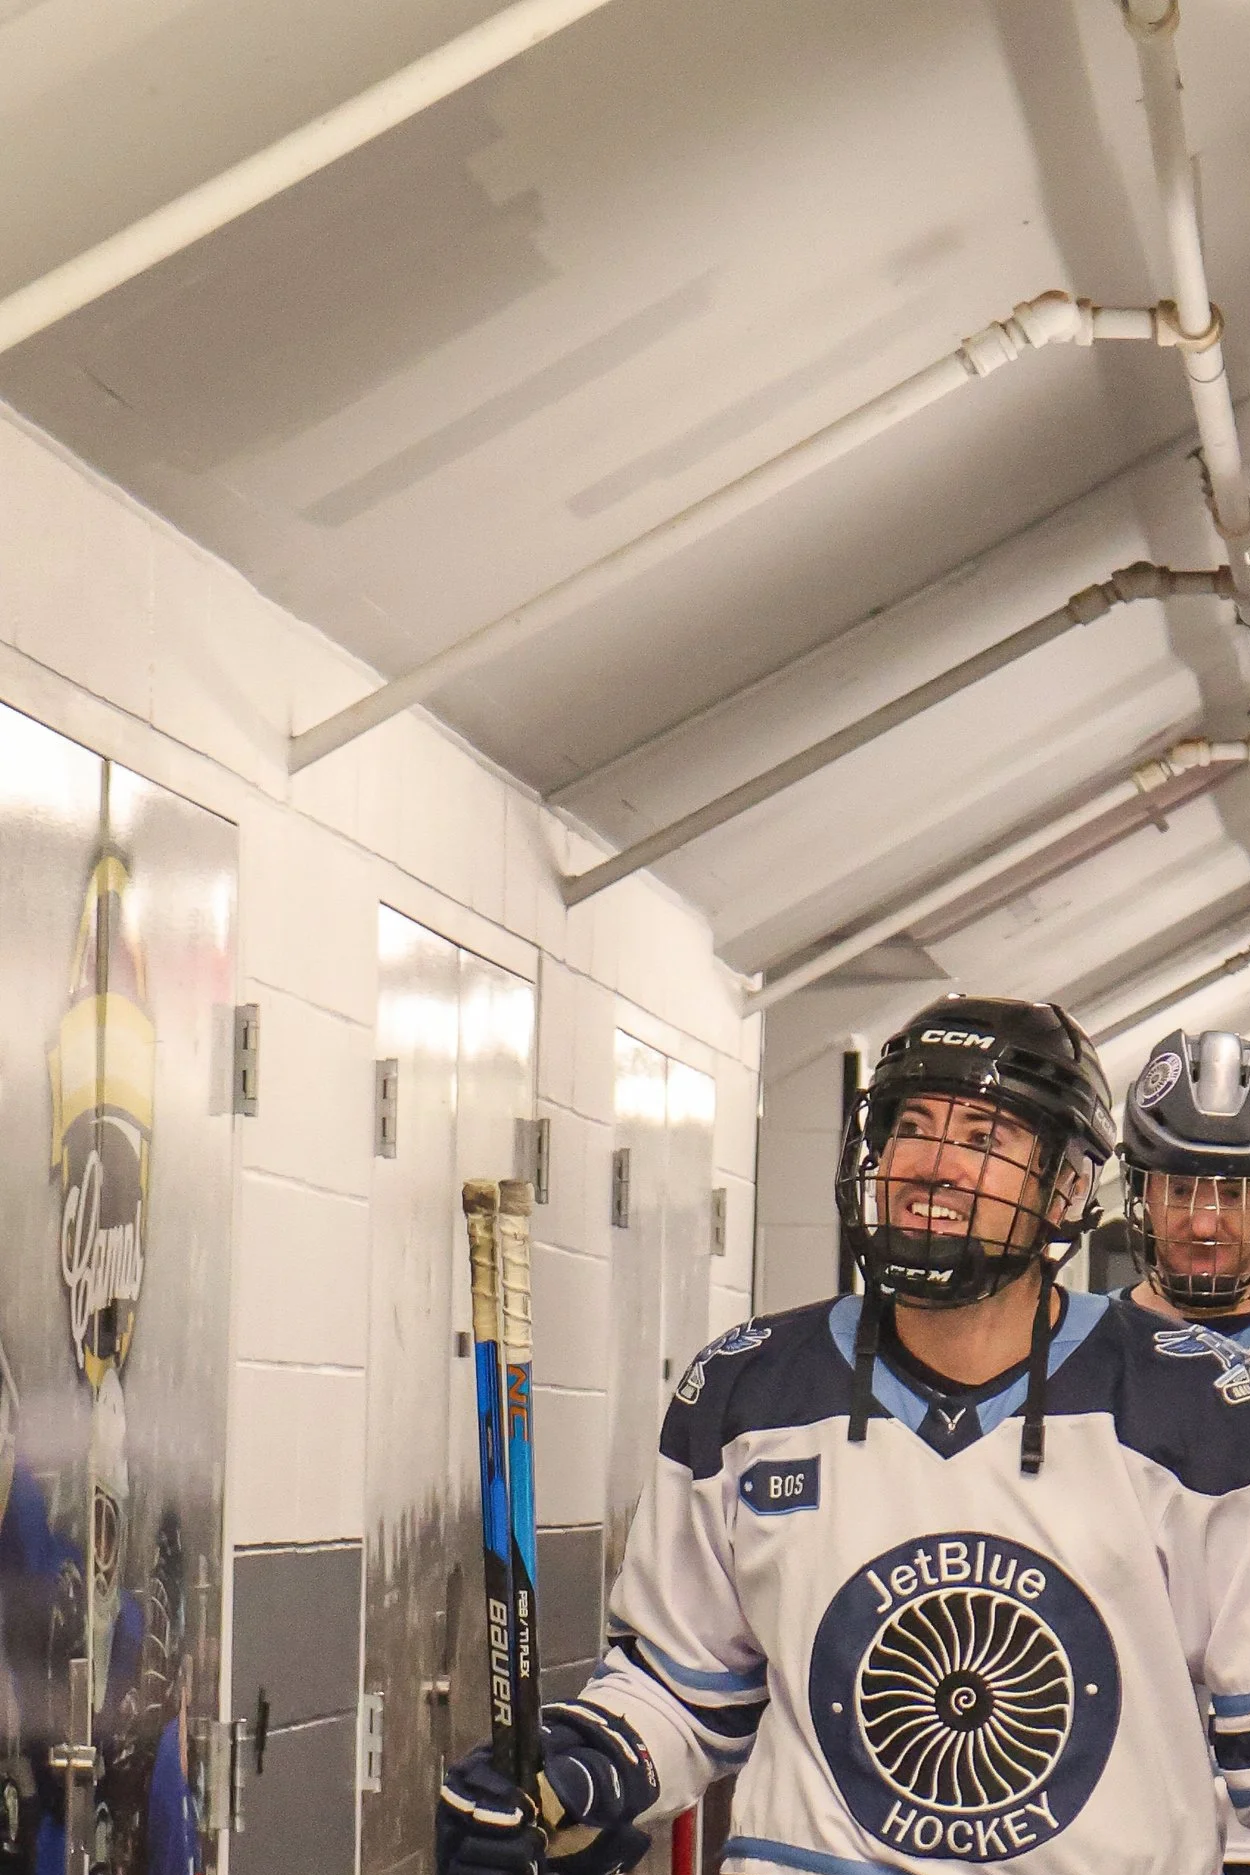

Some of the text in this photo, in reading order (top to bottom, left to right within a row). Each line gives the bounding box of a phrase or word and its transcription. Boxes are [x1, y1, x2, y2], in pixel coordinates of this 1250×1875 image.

[920, 1029, 996, 1050] CCM
[769, 1473, 805, 1499] BOS
[867, 1540, 1047, 1614] JetBlue
[881, 1790, 1060, 1857] HOCKEY
